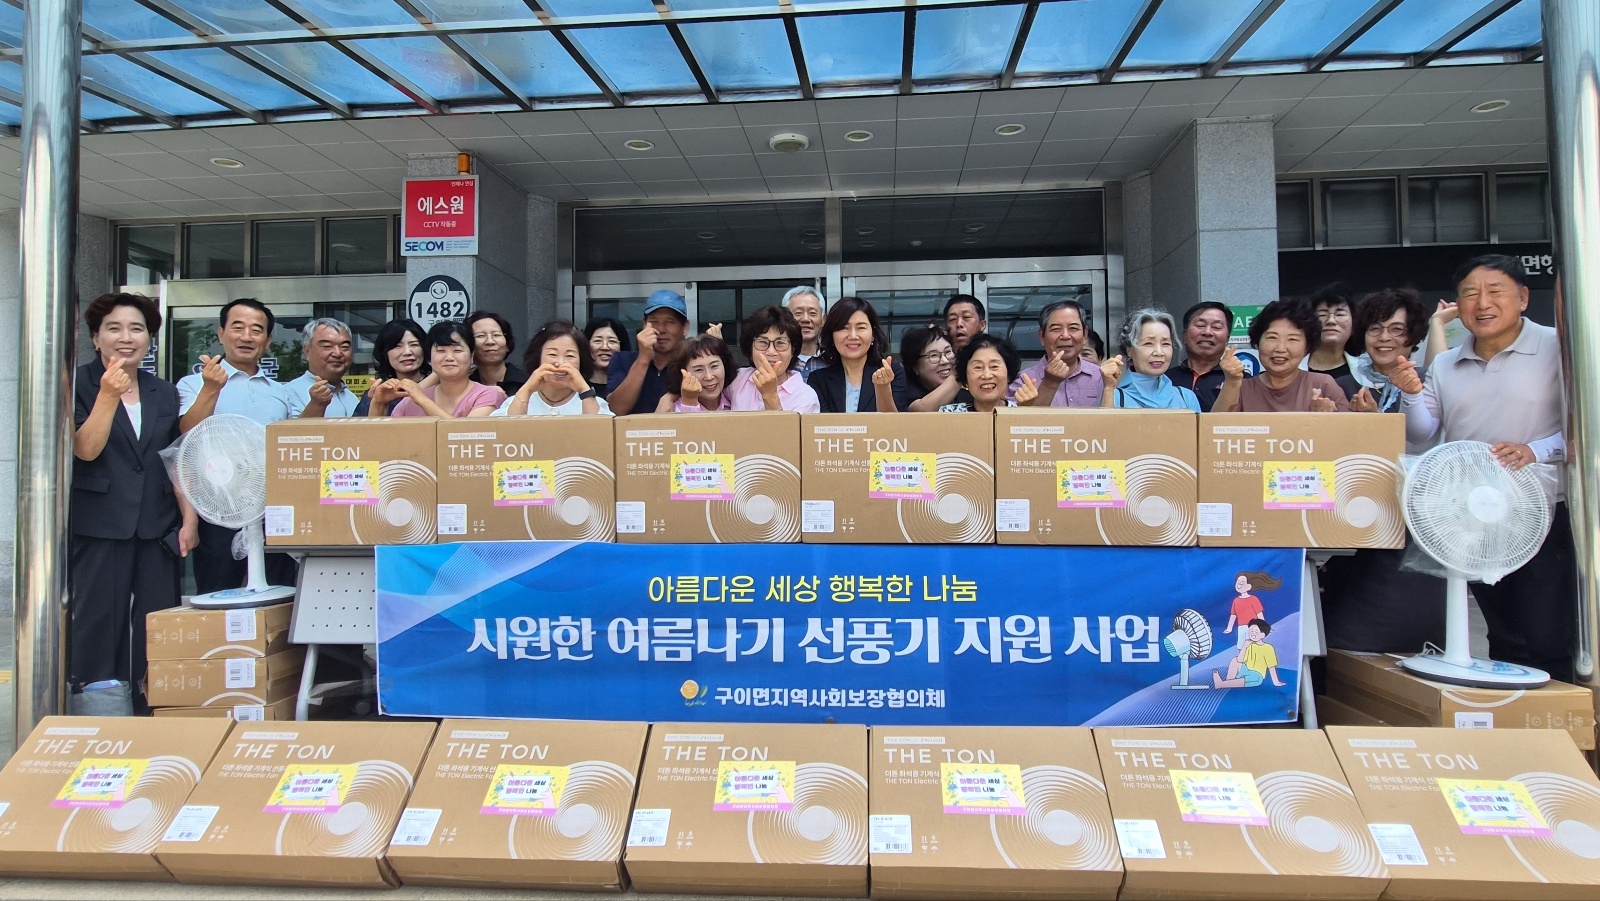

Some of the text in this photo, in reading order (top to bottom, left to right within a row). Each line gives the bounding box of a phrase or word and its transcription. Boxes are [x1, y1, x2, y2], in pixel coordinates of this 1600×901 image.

[417, 196, 464, 215] 에스원
[405, 241, 444, 251] SECOM
[415, 301, 464, 318] 1482
[448, 444, 533, 458] THE TON
[626, 441, 716, 456] THE TON
[814, 438, 907, 452] THE TON
[1010, 439, 1107, 453] THE TON
[1213, 439, 1314, 453] THE TON
[278, 447, 359, 461] THE TON
[649, 574, 978, 603] 아름다운 세상 행복한 나눔
[466, 614, 1160, 664] 시원한 여름나기 선풍기 지원 사업
[714, 687, 946, 708] 구이면지역사회보장협의체
[34, 740, 132, 755] THE TON
[233, 744, 335, 759] THE TON
[446, 743, 548, 759] THE TON
[662, 746, 768, 761] THE TON
[884, 749, 995, 764] THE TON
[1114, 752, 1232, 769] THE TON
[1354, 752, 1479, 771] THE TON
